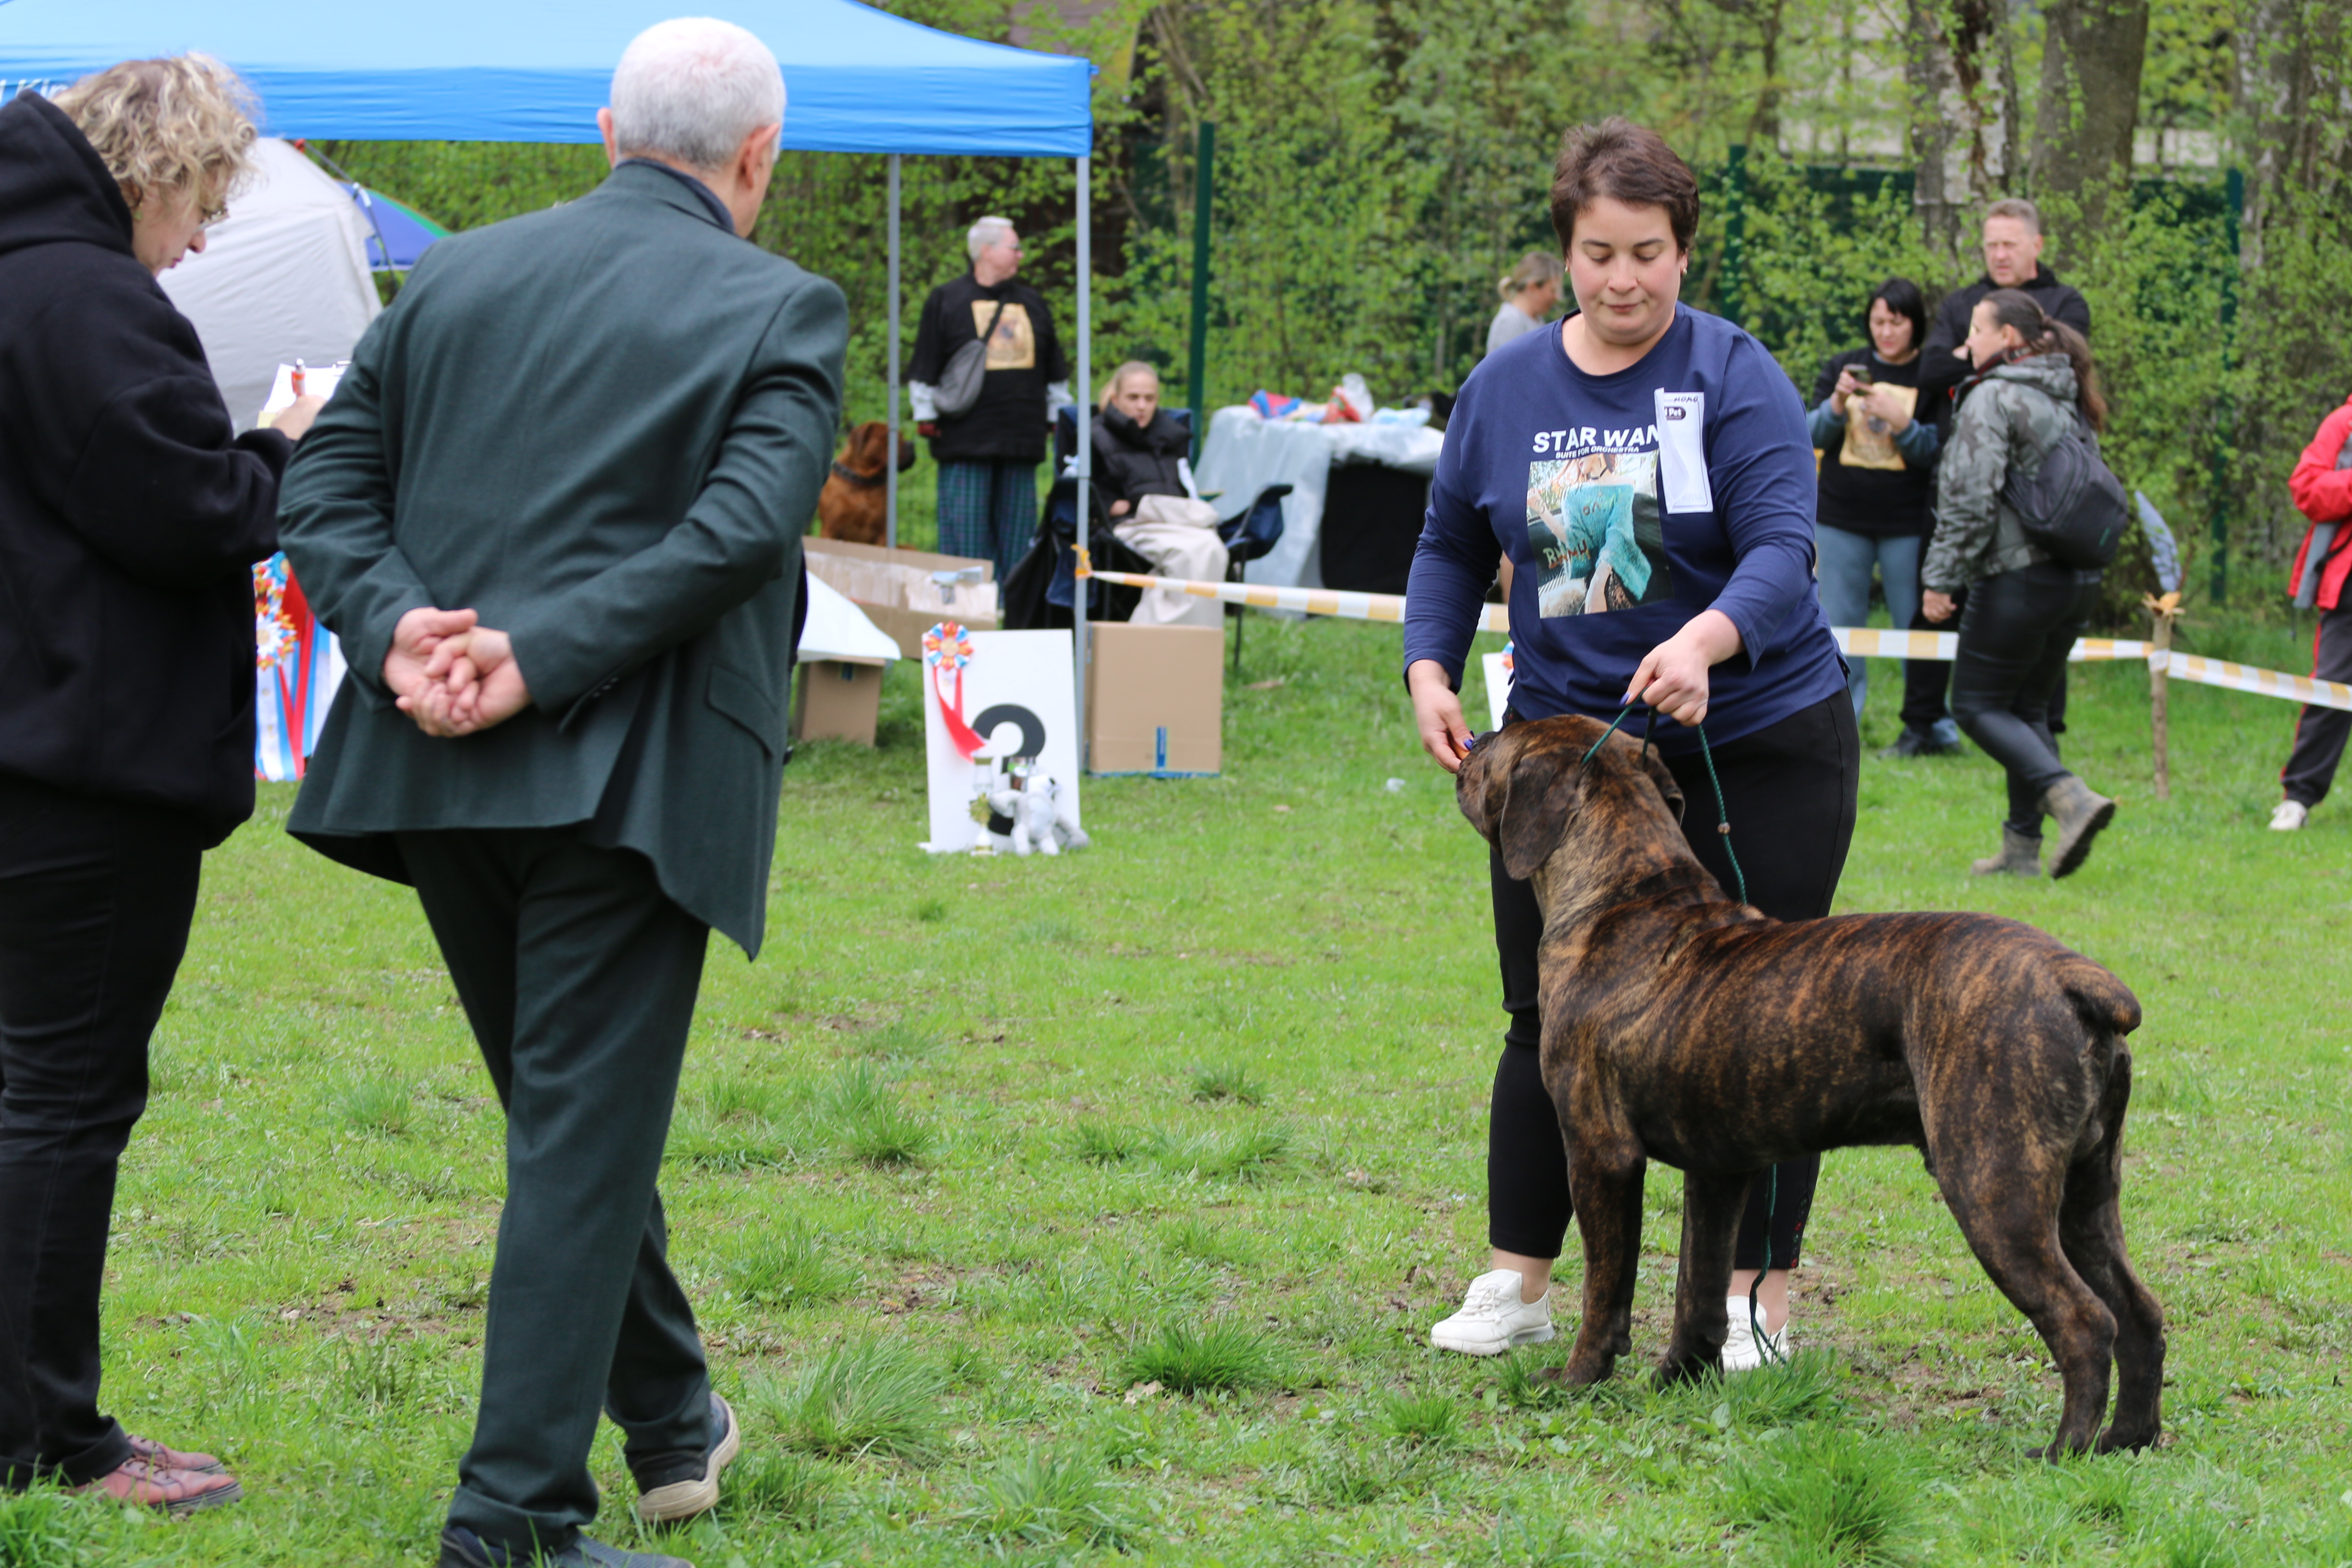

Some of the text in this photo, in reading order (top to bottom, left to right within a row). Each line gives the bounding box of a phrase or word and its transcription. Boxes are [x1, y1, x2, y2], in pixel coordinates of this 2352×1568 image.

[1532, 426, 1597, 453] STAR
[1555, 445, 1640, 459] SUITE FOR ORCHESTRA
